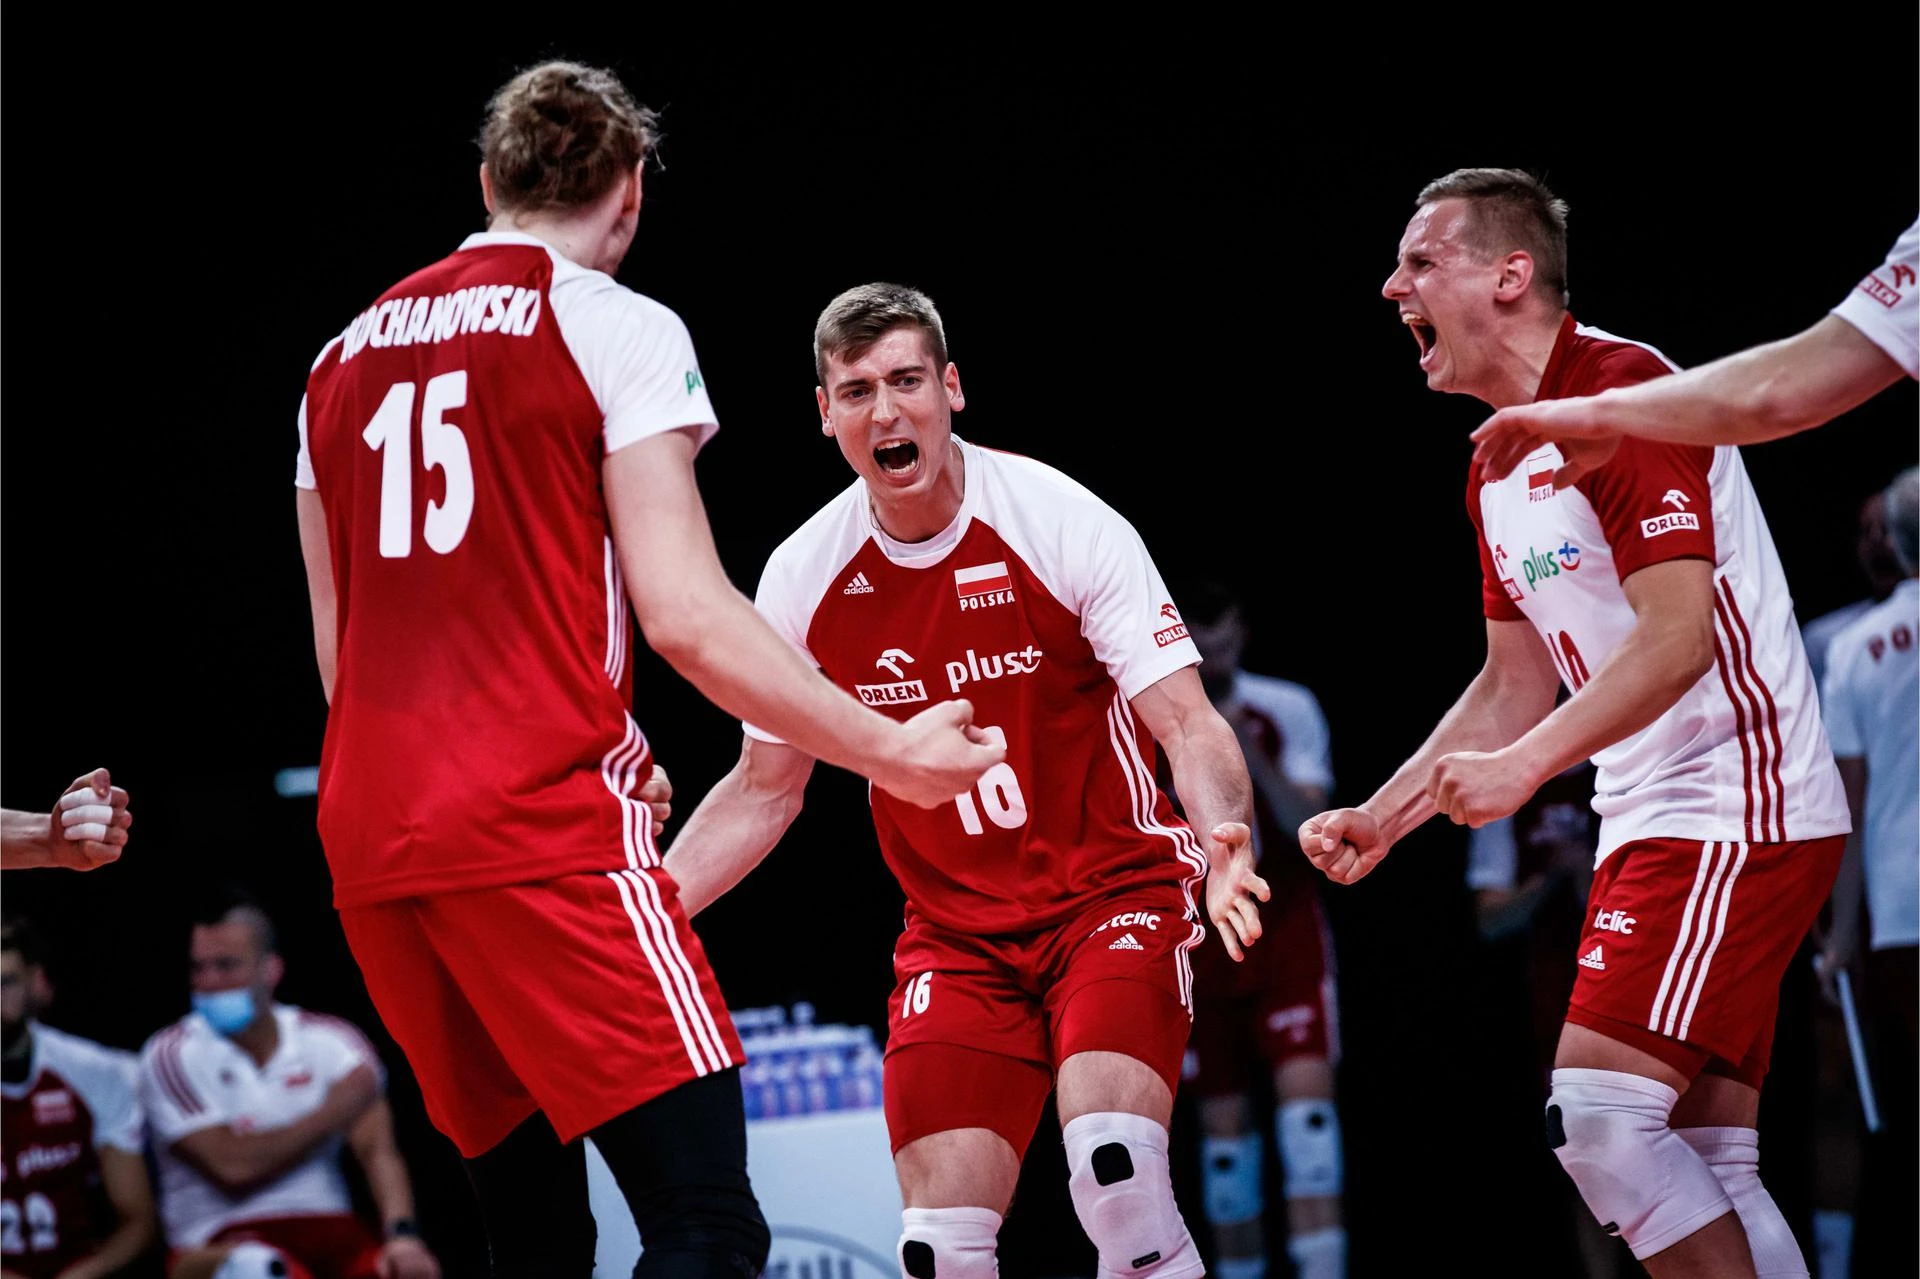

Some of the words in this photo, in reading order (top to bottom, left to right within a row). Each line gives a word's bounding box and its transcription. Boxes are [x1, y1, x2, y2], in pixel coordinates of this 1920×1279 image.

[362, 370, 475, 558] 15
[1646, 515, 1696, 533] ORLEN
[843, 585, 875, 595] adidas
[959, 590, 1016, 612] POLSKA
[860, 683, 922, 703] ORLEN
[1108, 943, 1145, 951] adidas
[902, 970, 933, 1020] 16
